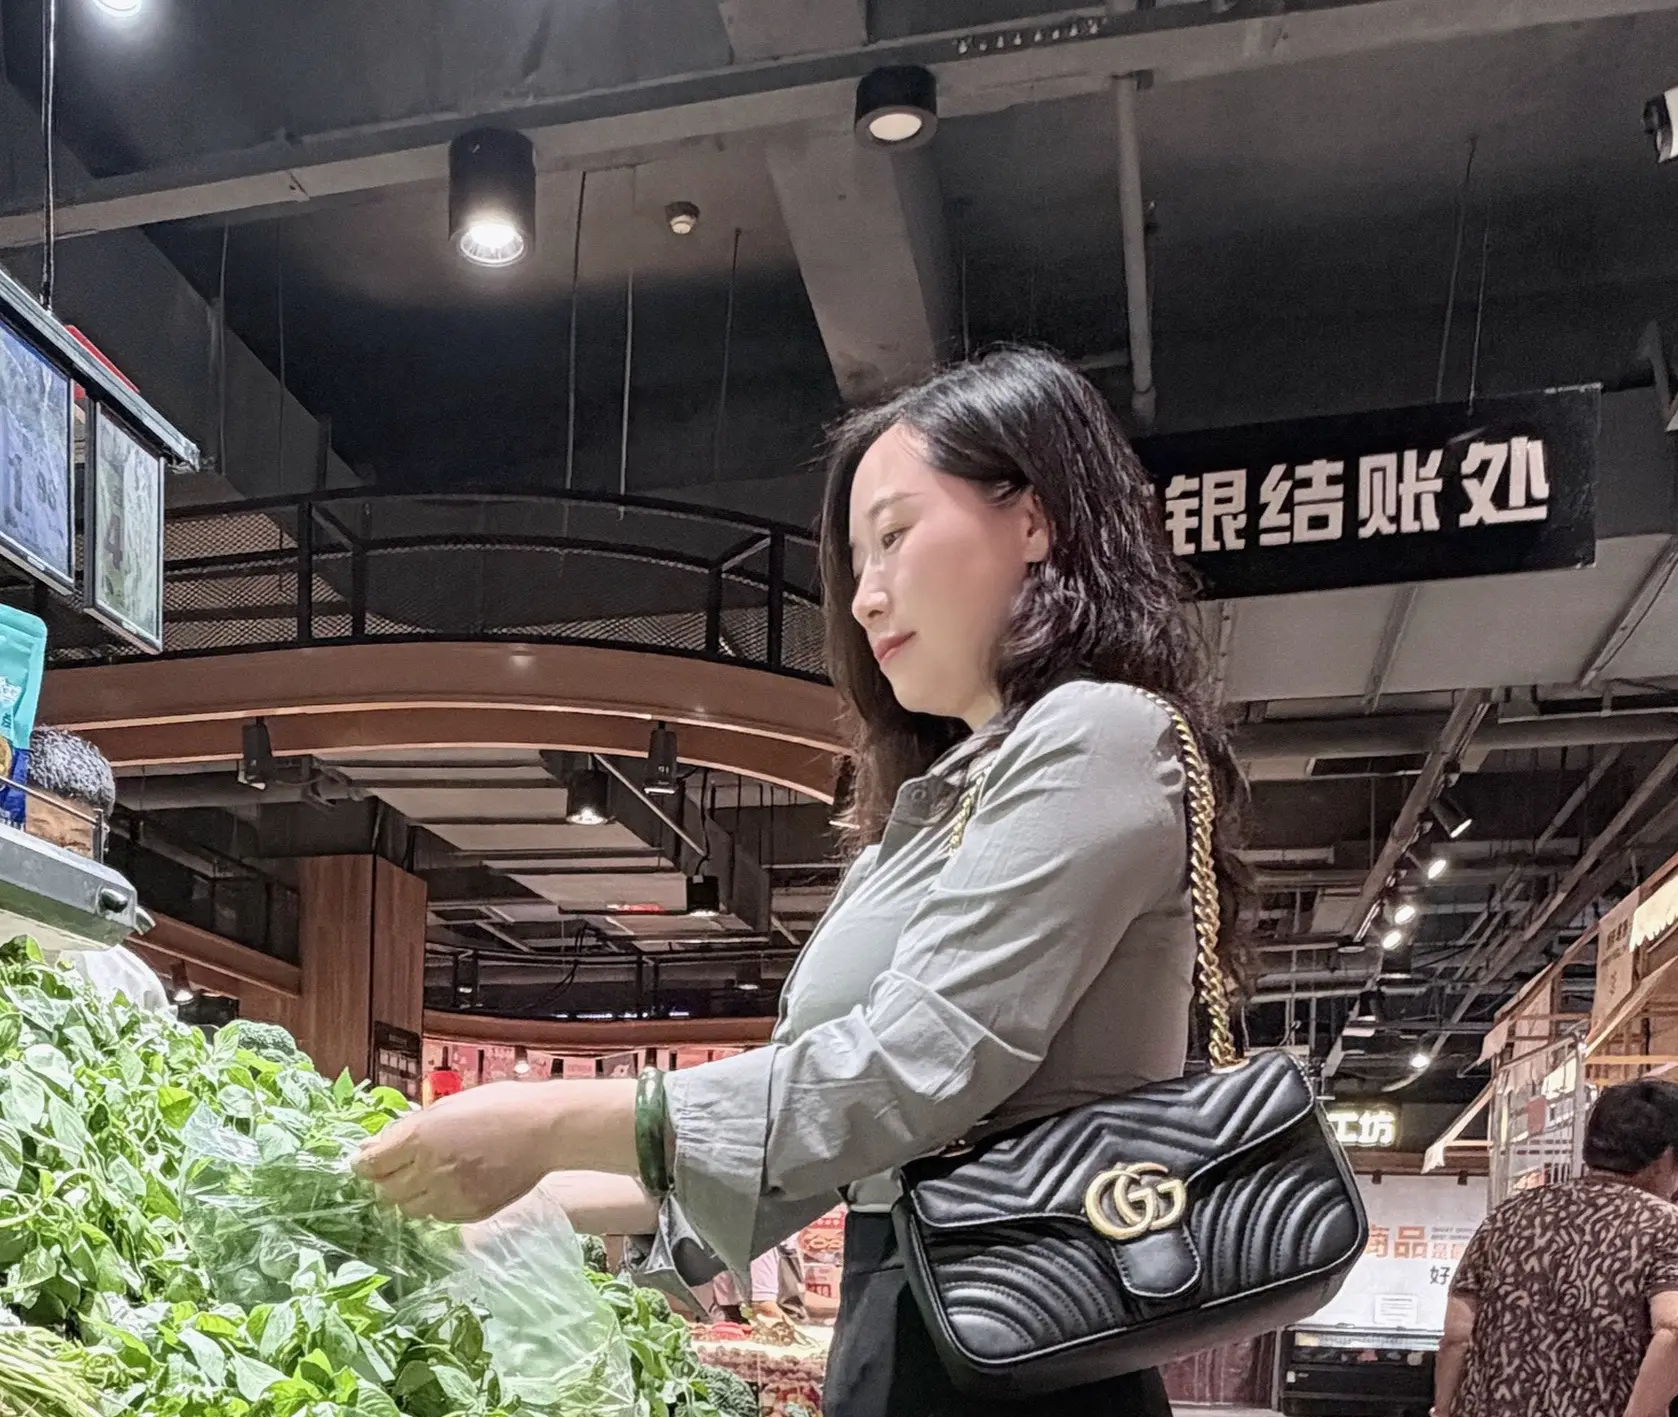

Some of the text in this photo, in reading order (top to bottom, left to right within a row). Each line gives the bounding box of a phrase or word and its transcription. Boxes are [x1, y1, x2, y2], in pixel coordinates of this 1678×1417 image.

[1141, 436, 1550, 556] 银结账处
[1326, 1109, 1396, 1144] 工坊
[1429, 1265, 1451, 1285] 好
